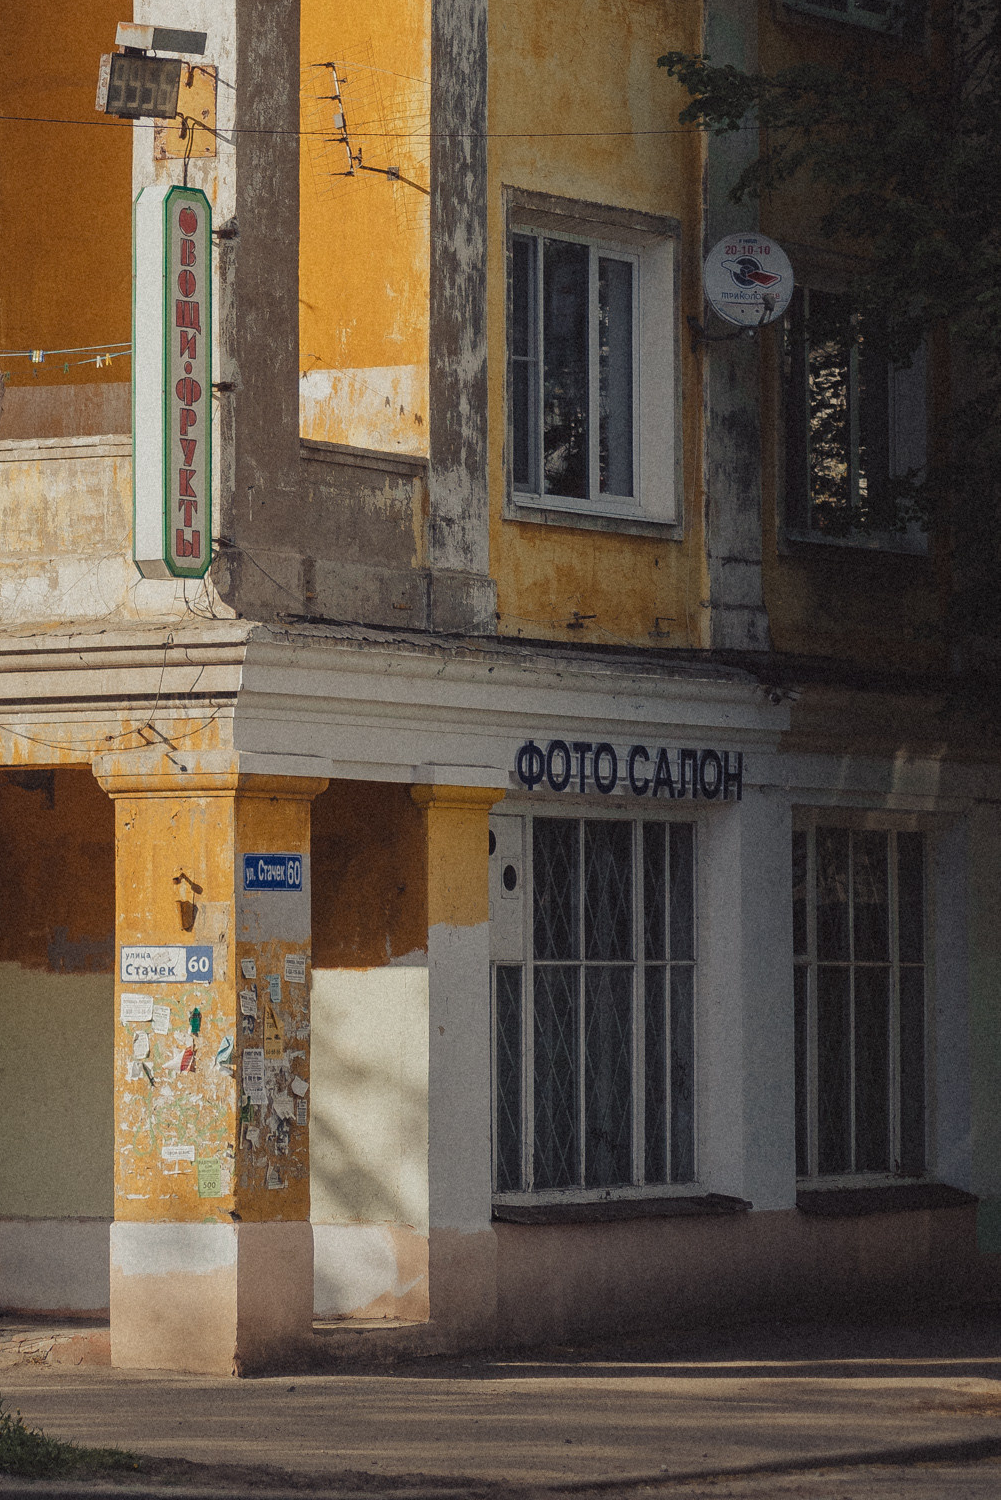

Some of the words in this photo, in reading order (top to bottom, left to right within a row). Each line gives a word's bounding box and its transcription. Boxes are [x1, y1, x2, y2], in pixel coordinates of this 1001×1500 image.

[725, 245, 771, 255] 20-10-10
[176, 376, 202, 559] ФРУКТЫ
[515, 739, 618, 795] ФОТО
[628, 744, 743, 801] САЛОН
[245, 867, 256, 885] ул.
[258, 859, 285, 881] Стачек
[287, 860, 301, 885] 60
[125, 952, 151, 961] улица
[125, 963, 176, 976] Стачек
[187, 956, 210, 973] 60
[203, 1181, 216, 1189] 500
